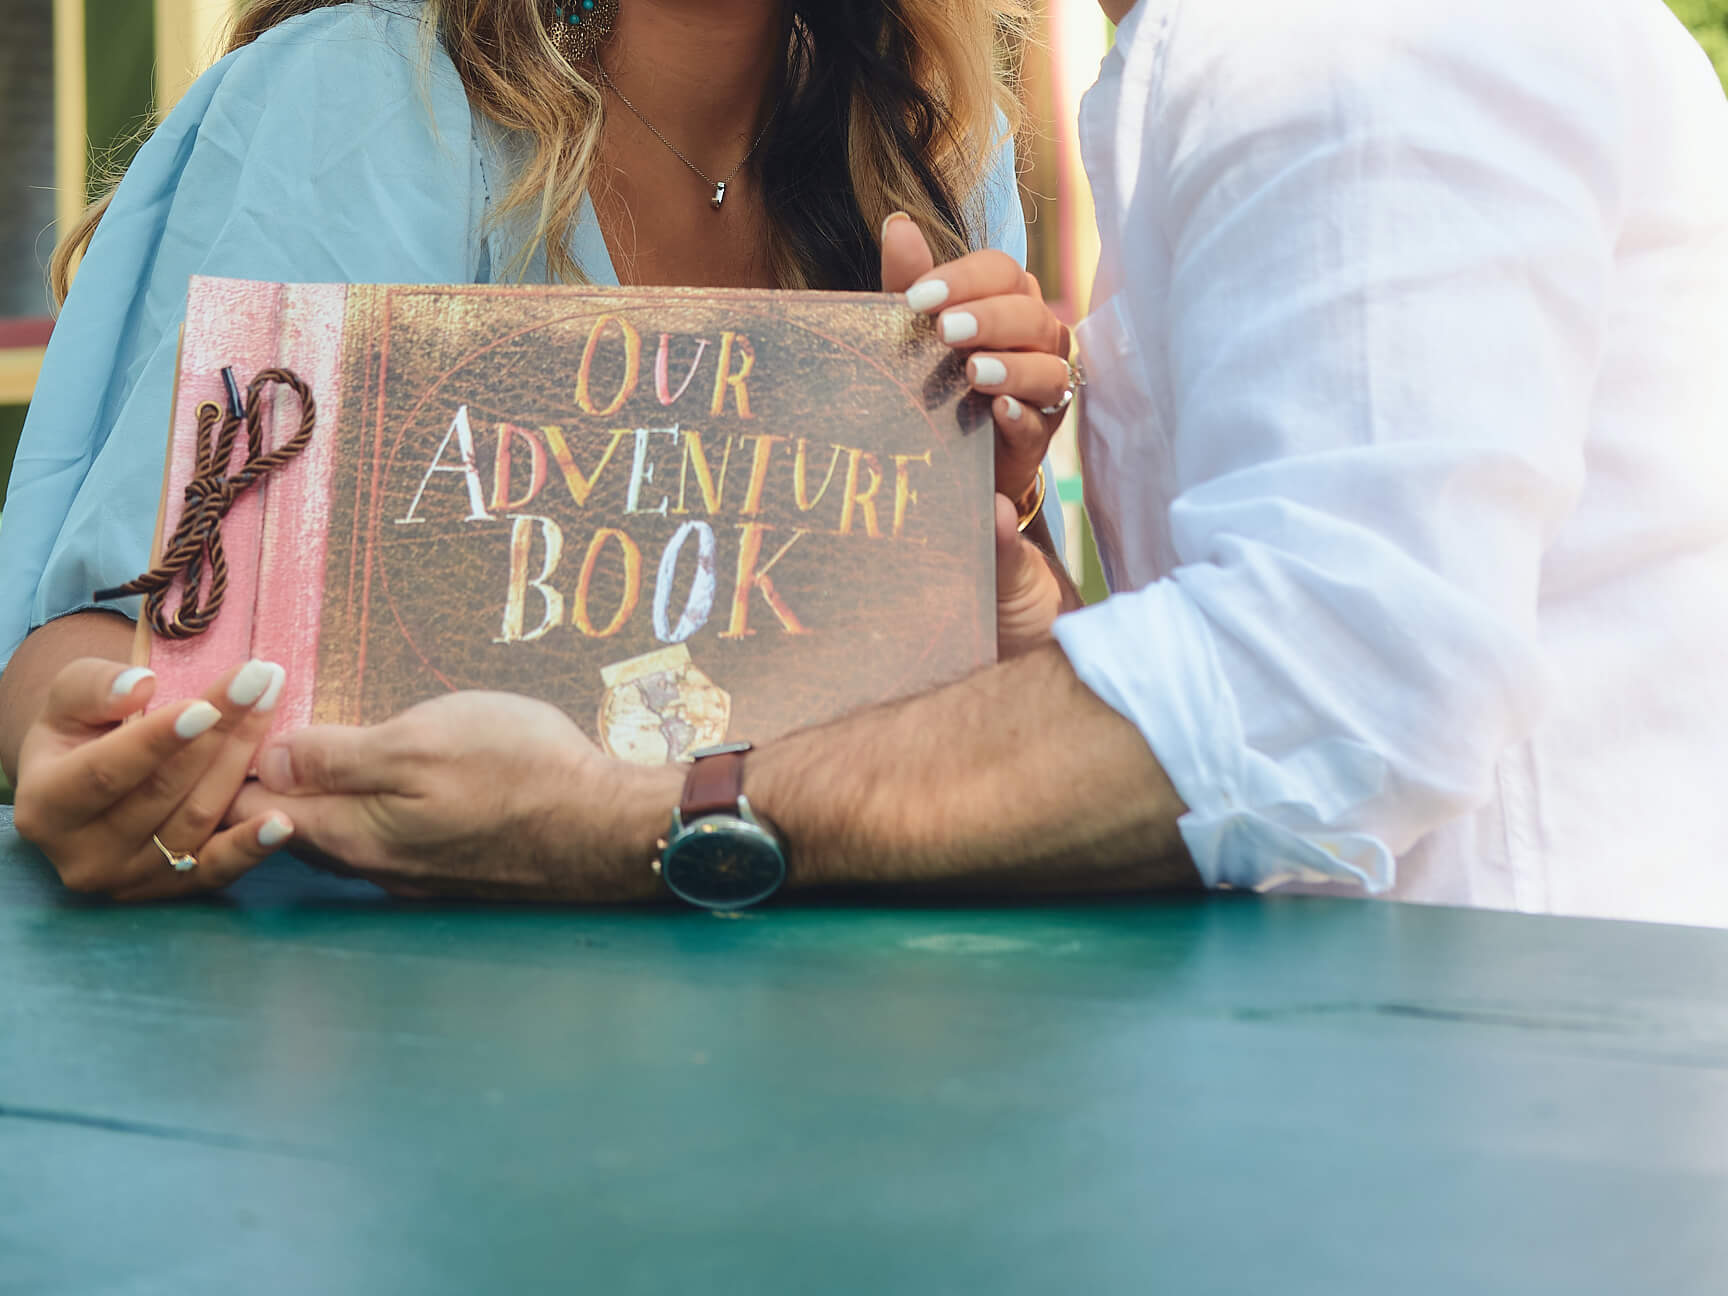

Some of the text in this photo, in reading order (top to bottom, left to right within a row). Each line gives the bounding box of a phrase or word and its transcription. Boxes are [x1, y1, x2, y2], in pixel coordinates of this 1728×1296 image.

[575, 314, 755, 419] OUR
[395, 405, 931, 545] ADVENTURE
[493, 513, 813, 642] BOOK
